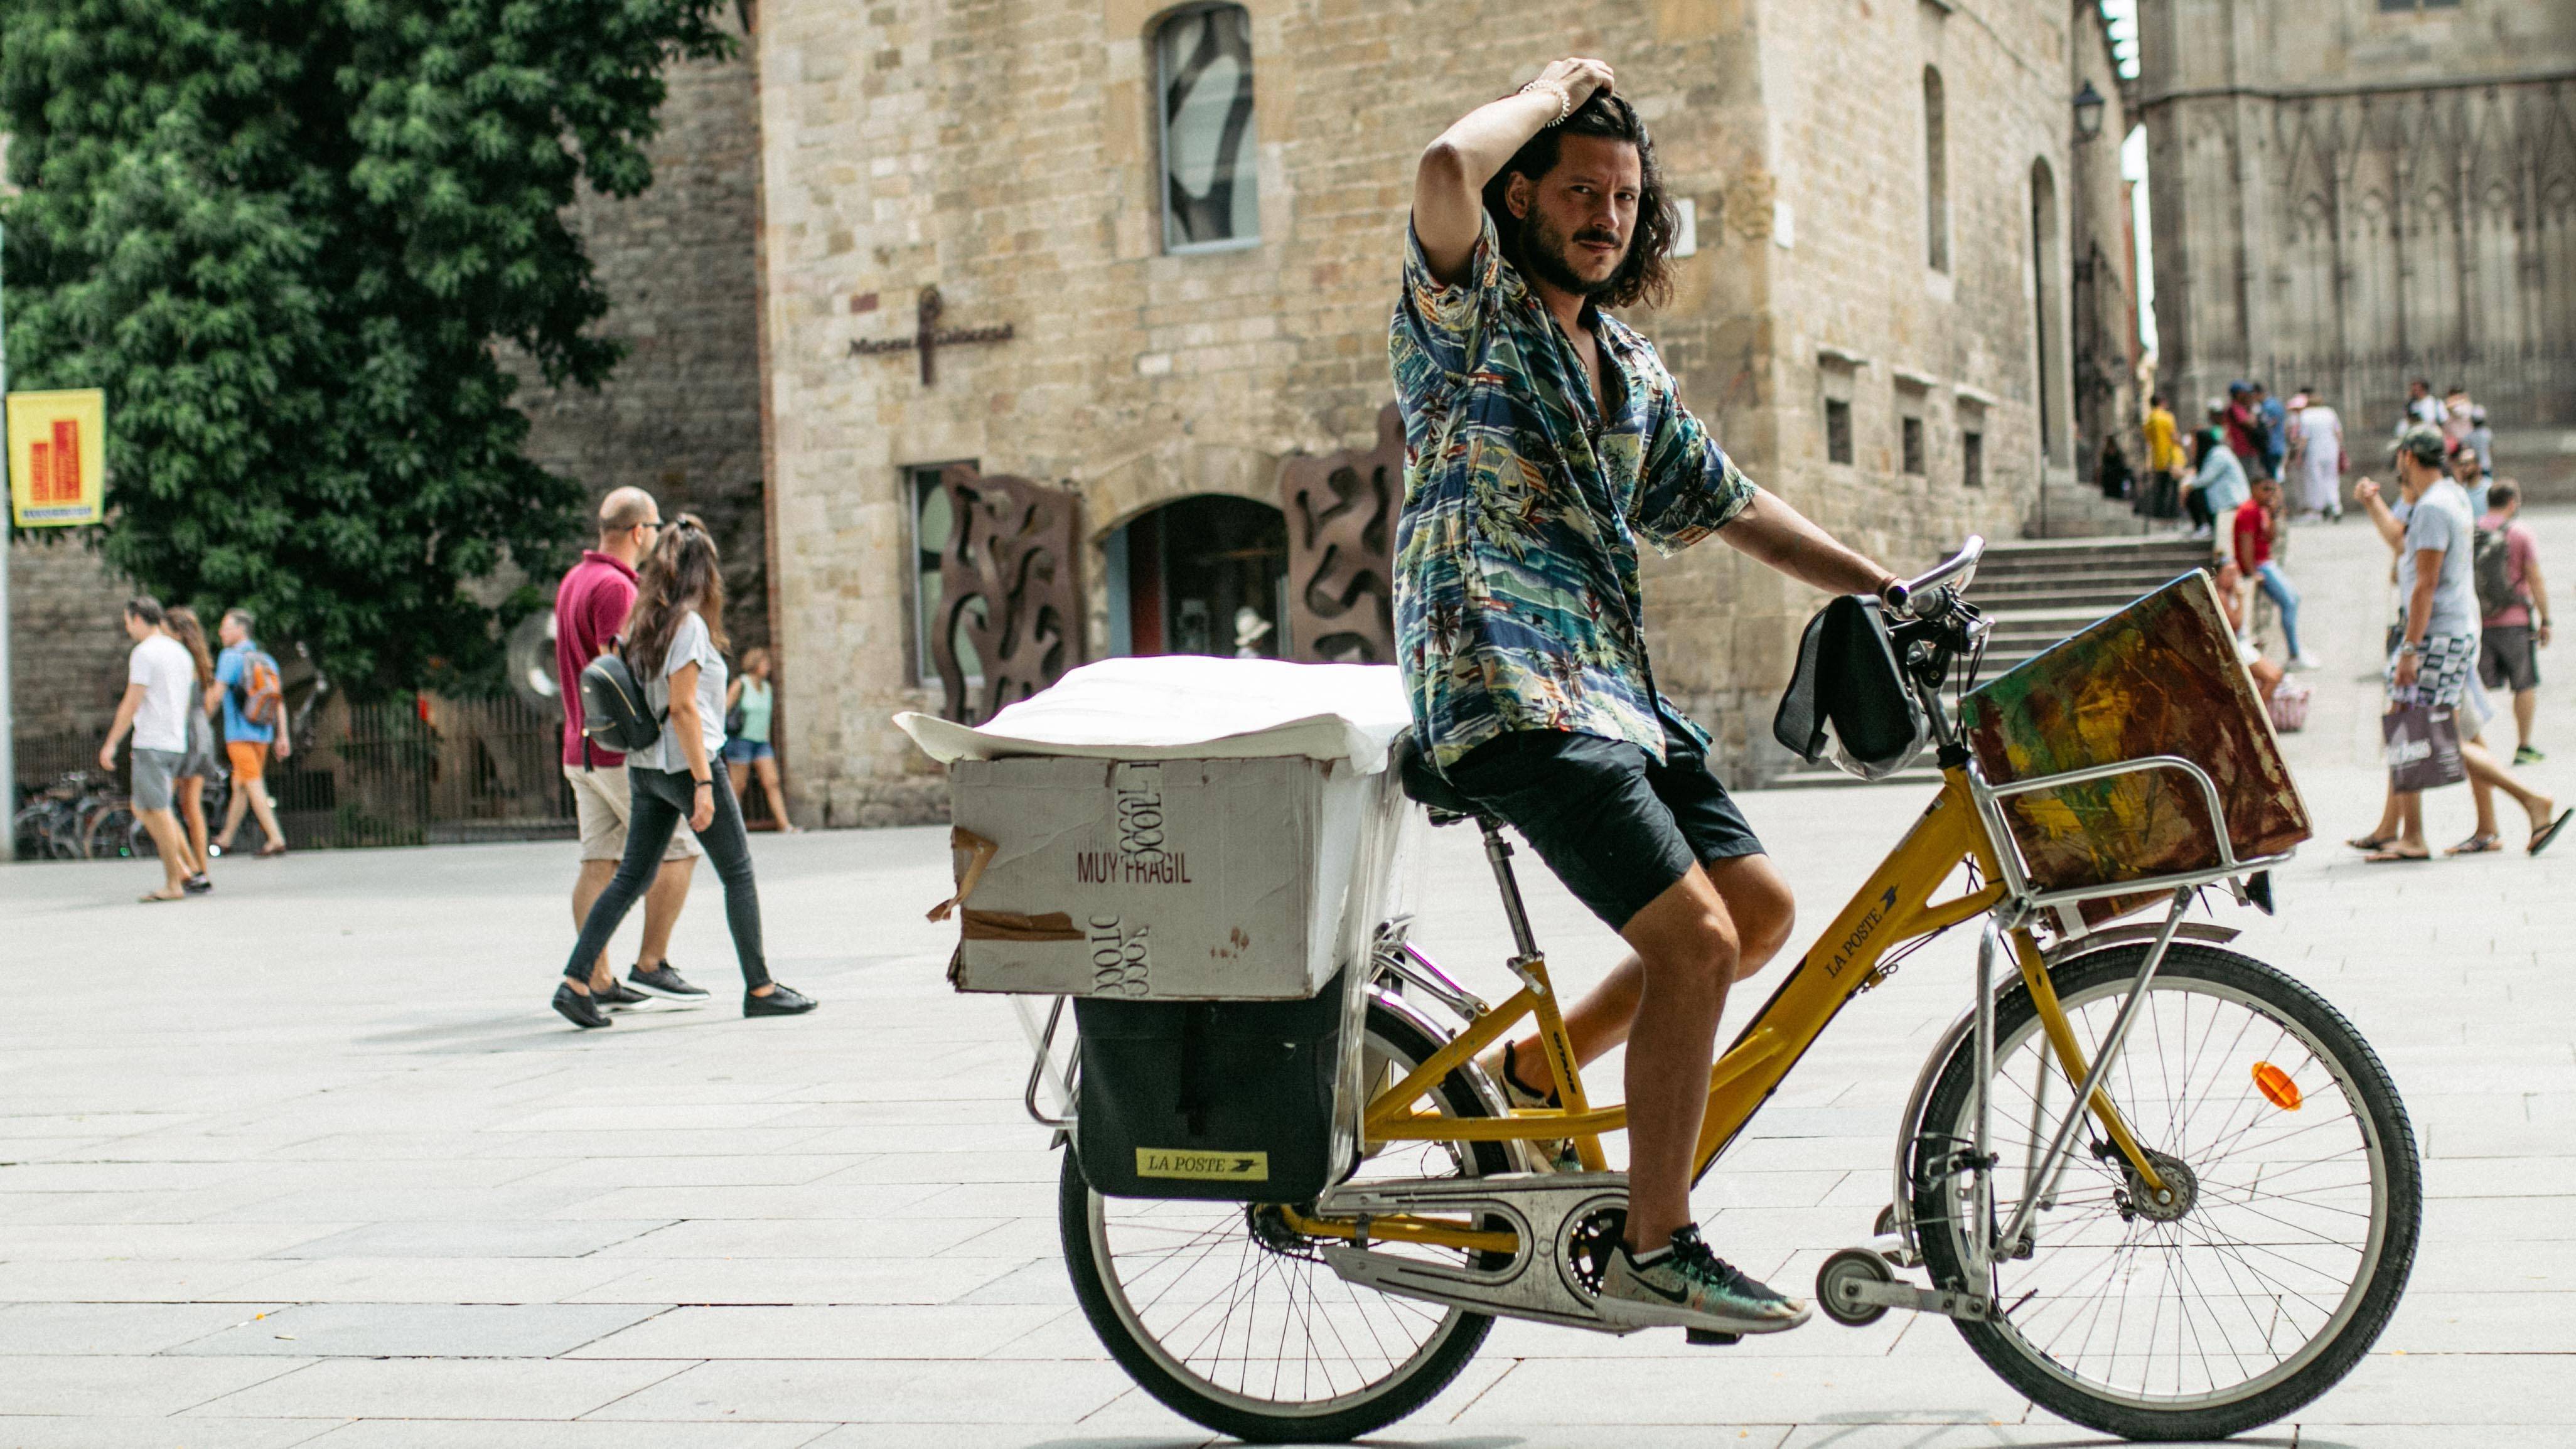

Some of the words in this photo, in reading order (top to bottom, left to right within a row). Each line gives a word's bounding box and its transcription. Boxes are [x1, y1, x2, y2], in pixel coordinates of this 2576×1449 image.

[1078, 852, 1118, 884] MUY
[1825, 954, 1847, 979] LA
[1842, 907, 1882, 958] POSTE
[1149, 1155, 1169, 1171] LA
[1174, 1156, 1226, 1173] POSTE
